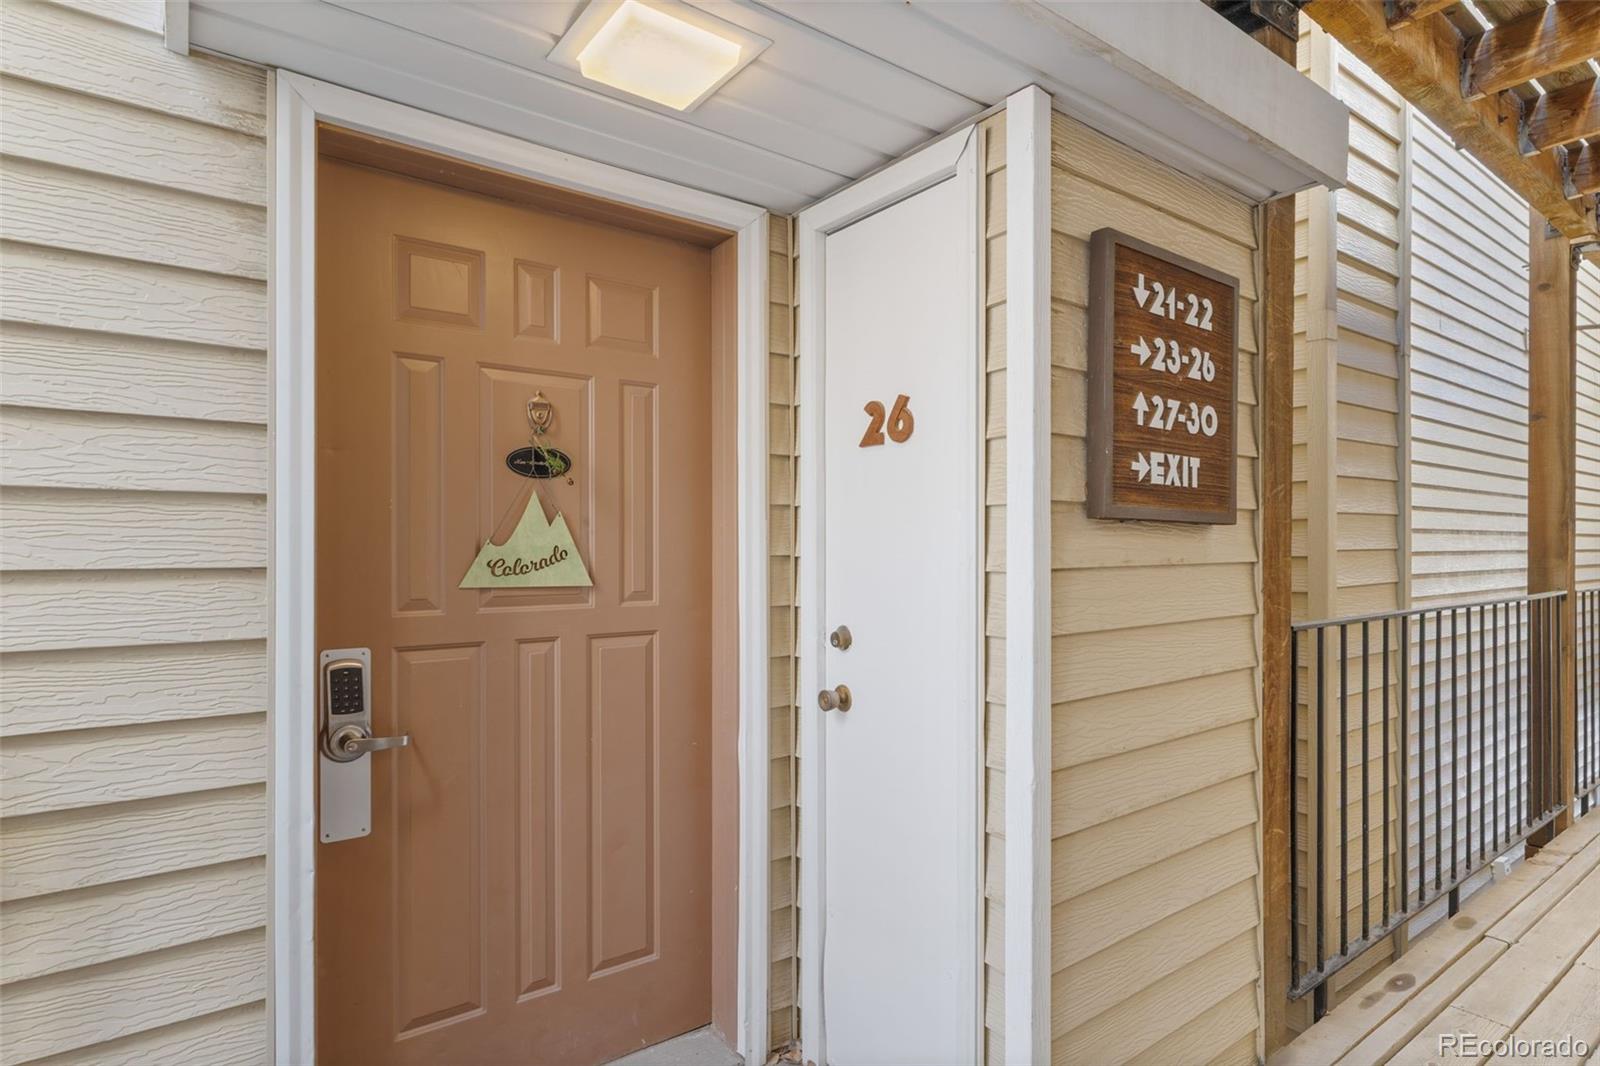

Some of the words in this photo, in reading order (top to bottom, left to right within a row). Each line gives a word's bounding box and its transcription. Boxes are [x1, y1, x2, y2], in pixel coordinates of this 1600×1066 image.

[1149, 282, 1213, 331] 21-22
[1151, 337, 1215, 382] 23-26
[859, 394, 914, 448] 26
[1150, 395, 1218, 437] 27-30
[1150, 451, 1201, 489] EXIT
[486, 545, 569, 578] Colorado
